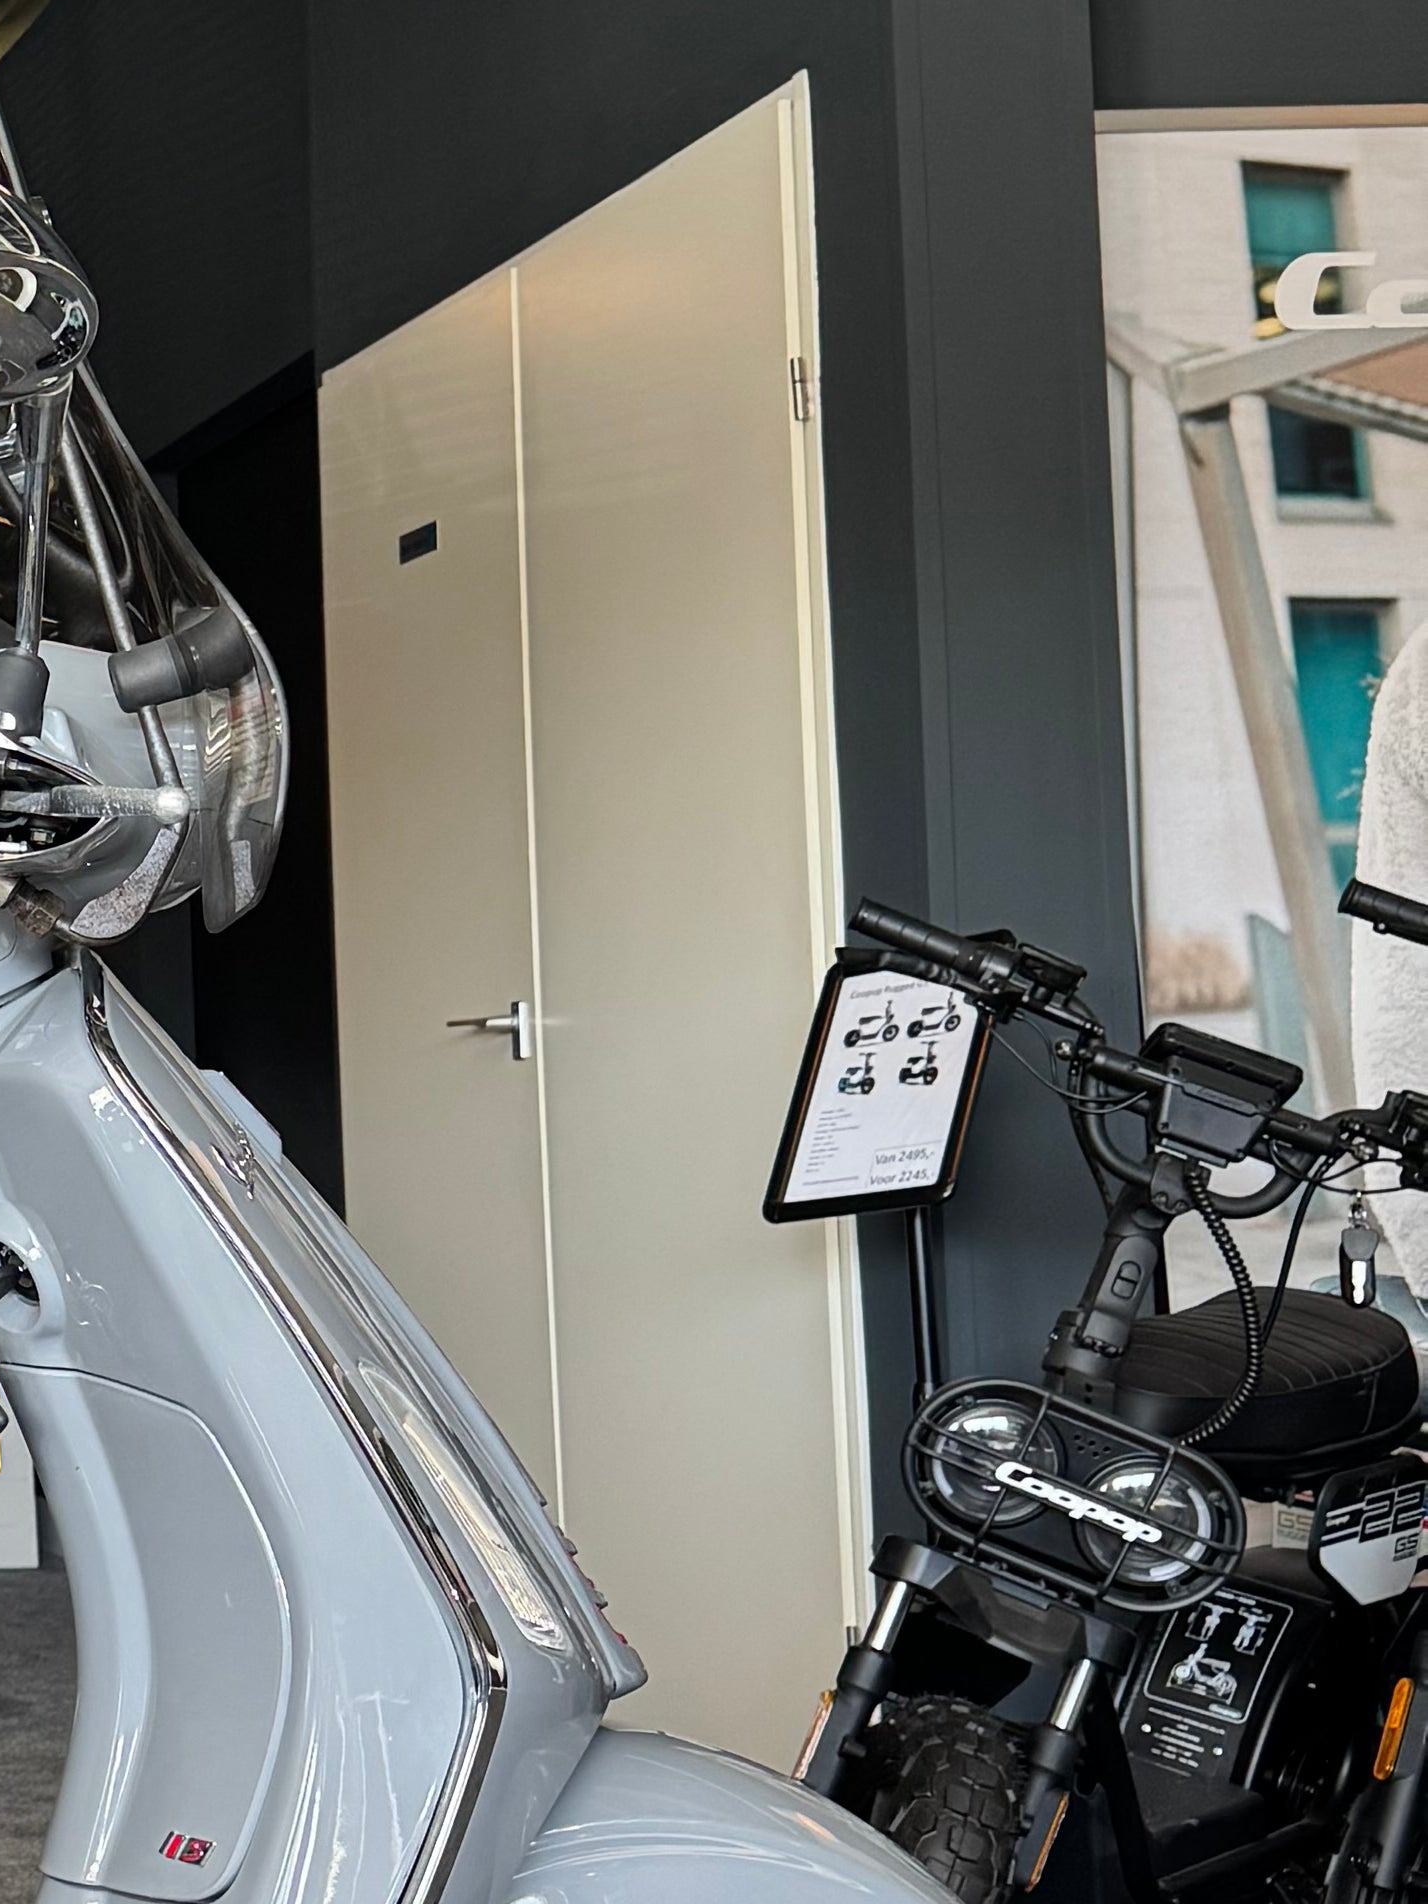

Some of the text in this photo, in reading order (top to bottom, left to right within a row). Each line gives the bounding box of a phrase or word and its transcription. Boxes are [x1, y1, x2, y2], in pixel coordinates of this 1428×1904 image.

[875, 1153, 897, 1165] Van
[870, 1174, 897, 1186] Voor
[995, 1461, 1162, 1543] Coopop
[1358, 1480, 1426, 1543] 22
